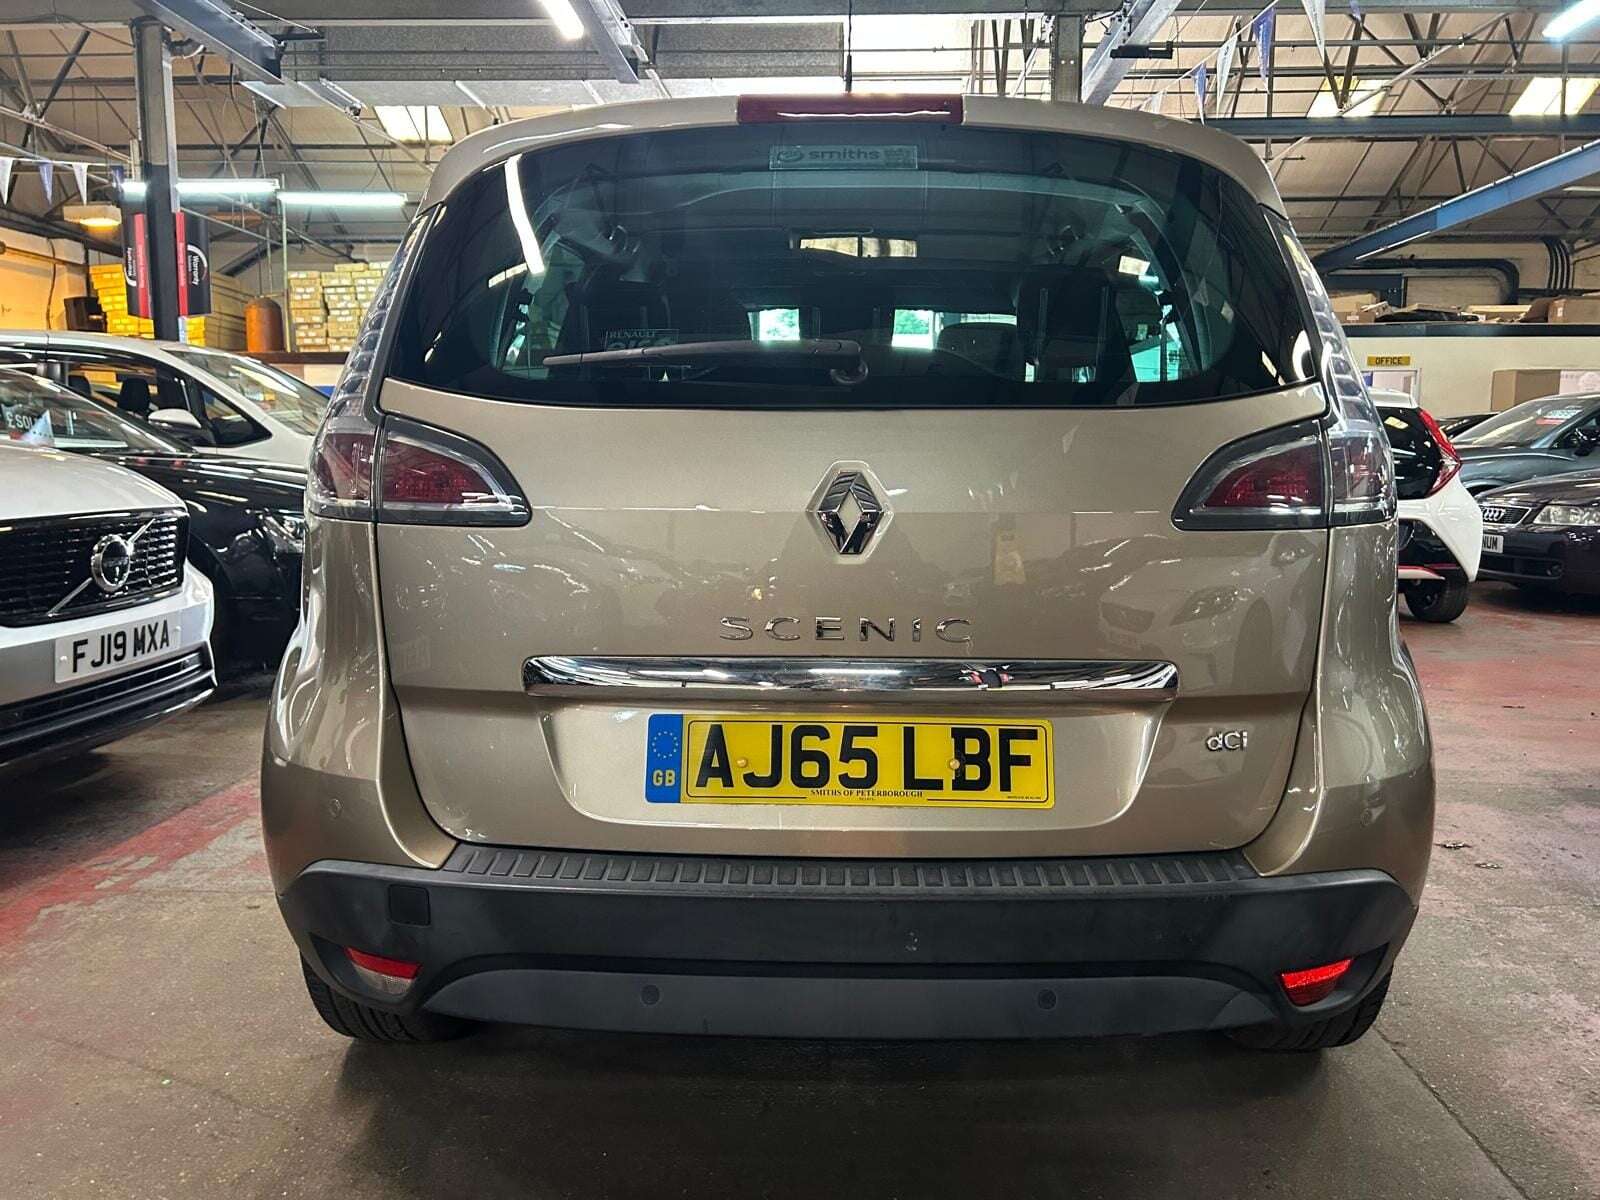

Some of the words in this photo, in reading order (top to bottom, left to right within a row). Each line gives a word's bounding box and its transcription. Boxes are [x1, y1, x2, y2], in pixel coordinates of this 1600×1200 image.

[808, 147, 881, 161] smiths
[191, 255, 200, 286] Warranty
[1375, 356, 1403, 365] OFFICE
[719, 616, 974, 642] SCENIC
[72, 630, 127, 673] FJ19
[133, 619, 170, 657] MXA
[1205, 730, 1248, 751] dCi
[695, 723, 879, 790] AJ65
[903, 725, 1039, 793] LBF
[652, 769, 676, 787] GB
[810, 788, 842, 796] SMITHS
[843, 788, 854, 797] OF
[856, 789, 923, 798] PETERBOROUGH
